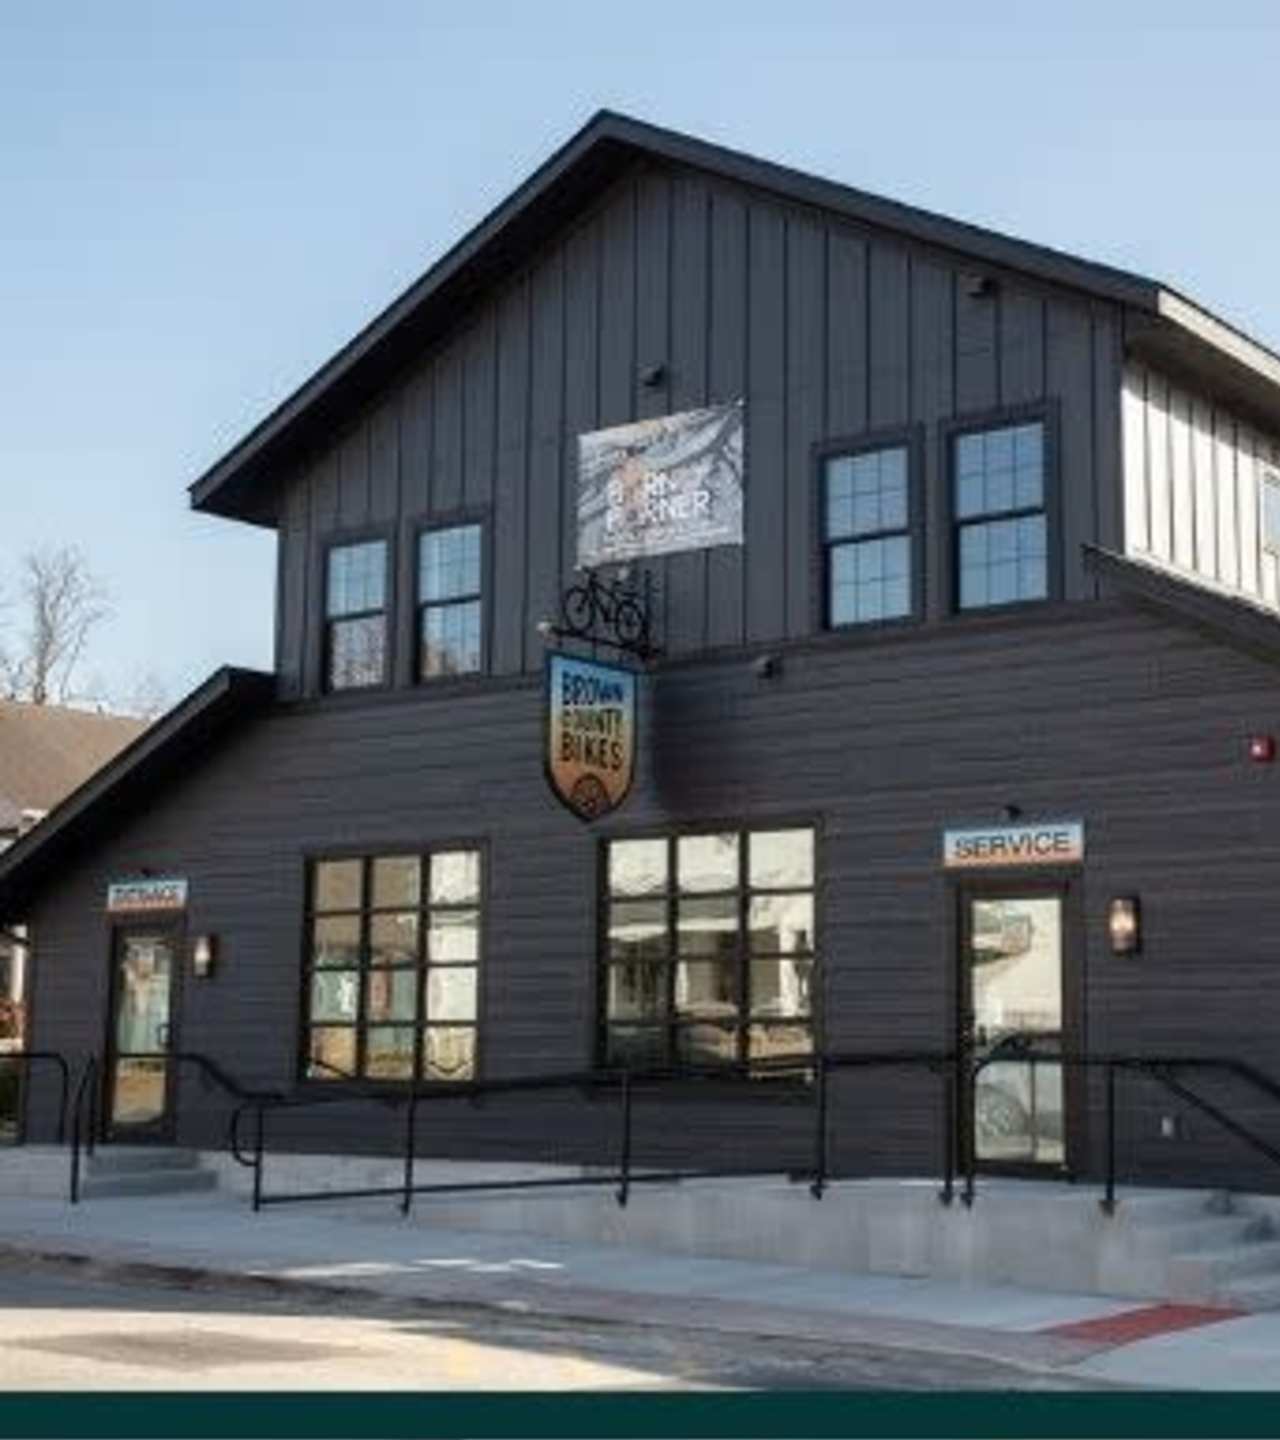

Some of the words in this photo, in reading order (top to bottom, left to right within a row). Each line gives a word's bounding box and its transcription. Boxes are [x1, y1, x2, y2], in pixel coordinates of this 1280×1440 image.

[562, 670, 624, 706] BROWN
[562, 707, 624, 738] COUNTY
[561, 731, 624, 772] BIKES
[955, 830, 1070, 860] SERVICE
